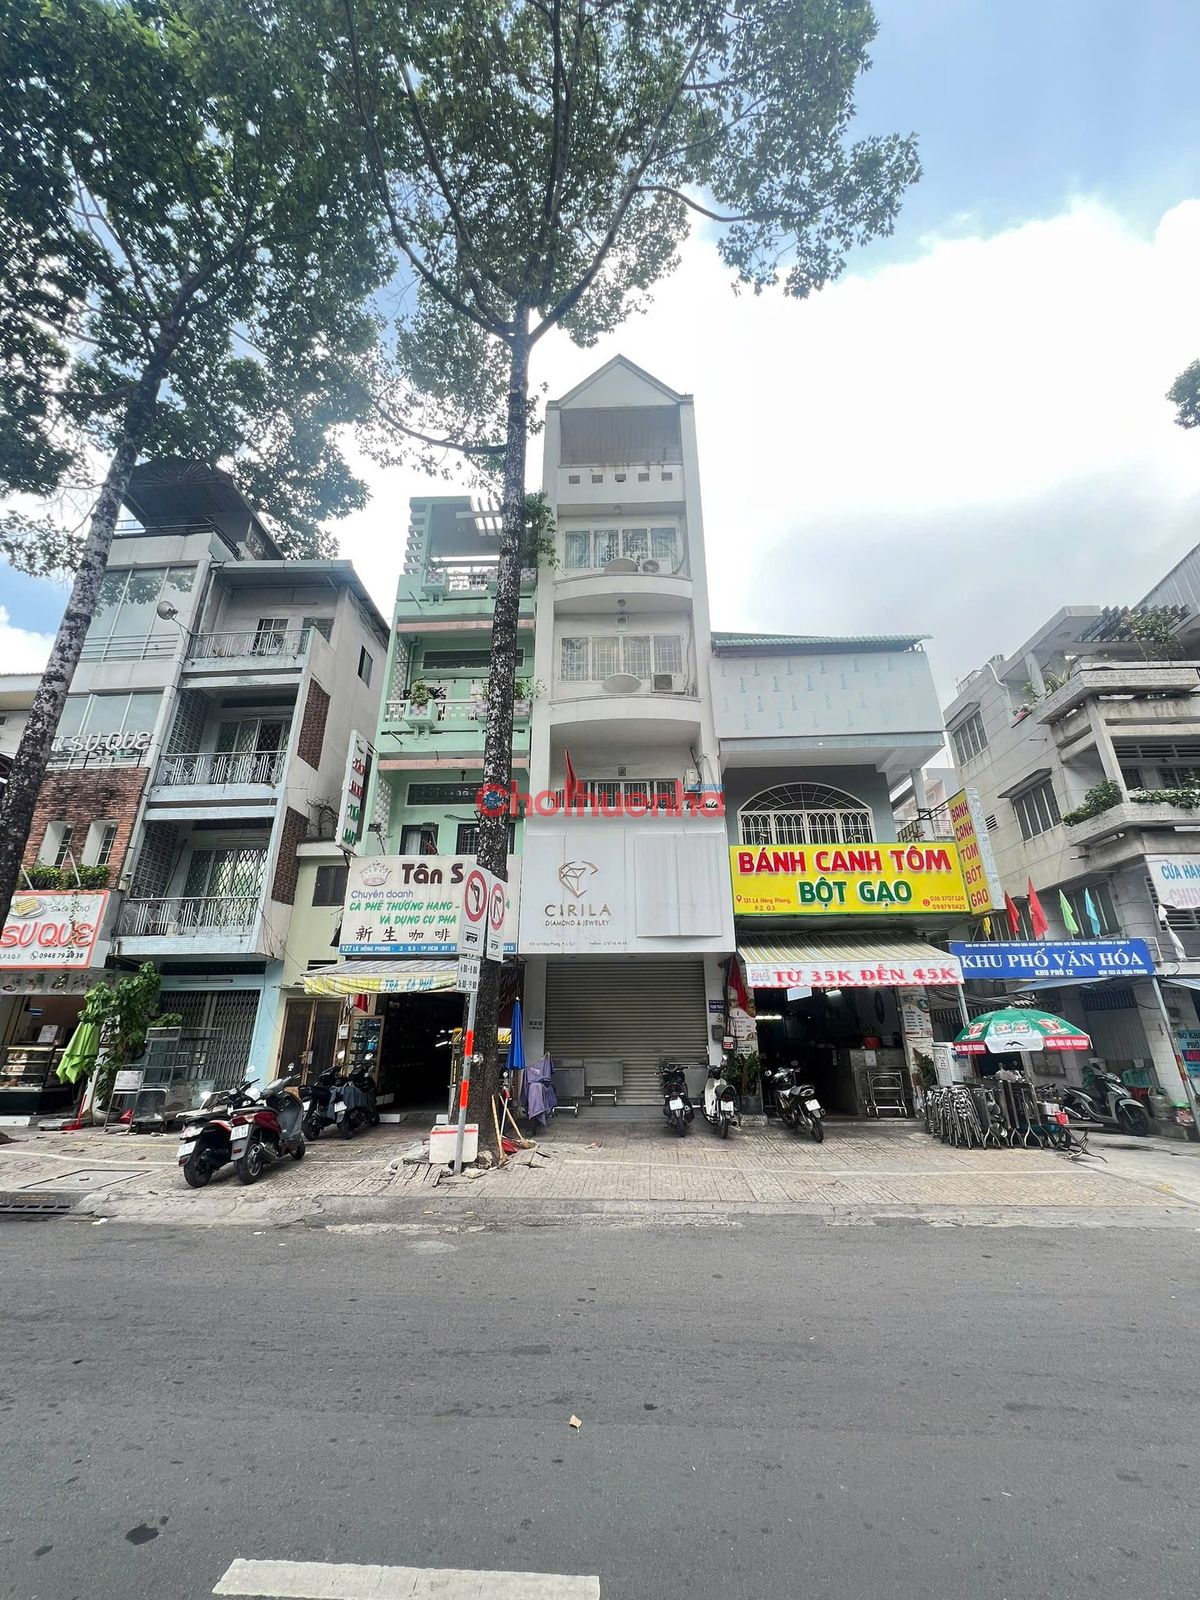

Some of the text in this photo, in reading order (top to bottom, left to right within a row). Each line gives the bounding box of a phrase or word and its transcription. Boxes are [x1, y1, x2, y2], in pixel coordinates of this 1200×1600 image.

[955, 821, 974, 842] CANH
[738, 845, 953, 873] BÁNH CANH TÔM
[402, 863, 443, 884] Tân
[351, 890, 413, 900] Chuyên doanh
[799, 877, 912, 907] BỘT GẠO
[438, 915, 457, 924] PHA
[544, 904, 611, 917] CIRILA
[961, 948, 1144, 968] KHU PHỐ VĂN HÓA
[773, 968, 803, 984] TỪ
[811, 970, 855, 983] 35K
[860, 963, 905, 981] ĐẾN
[912, 967, 958, 981] 45K
